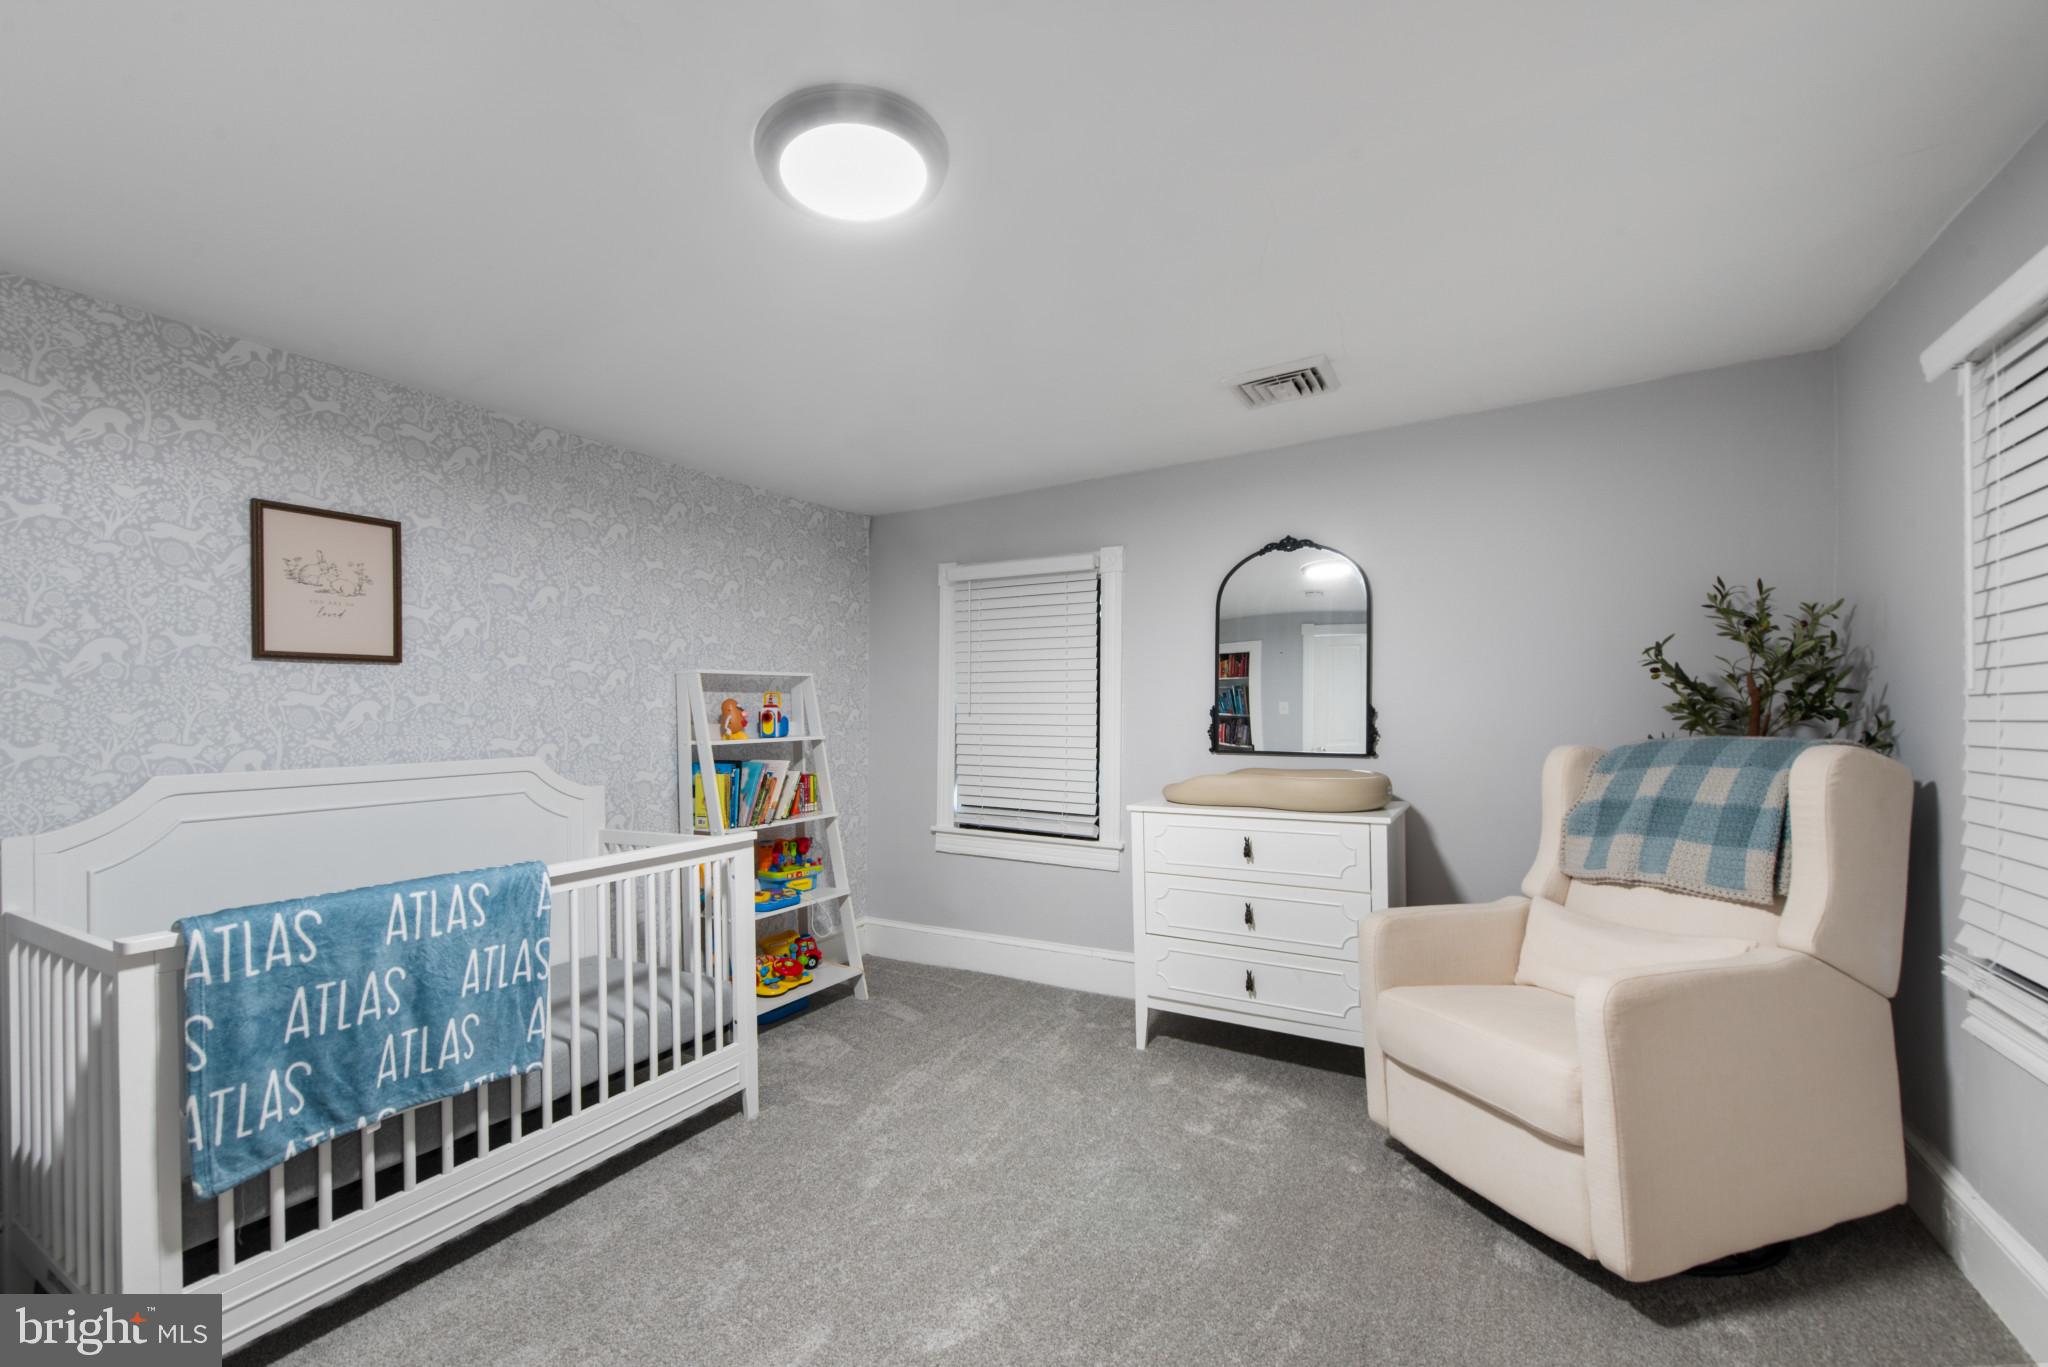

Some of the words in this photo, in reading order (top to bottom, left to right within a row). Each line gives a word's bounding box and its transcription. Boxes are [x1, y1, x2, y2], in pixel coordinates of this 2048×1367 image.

[185, 910, 323, 990] ATLAS
[386, 882, 490, 945] ATLAS
[284, 966, 406, 1044] ATLAS
[462, 936, 551, 998] ATLAS
[377, 1014, 480, 1088] ATLAS
[186, 1061, 312, 1152] ATLAS
